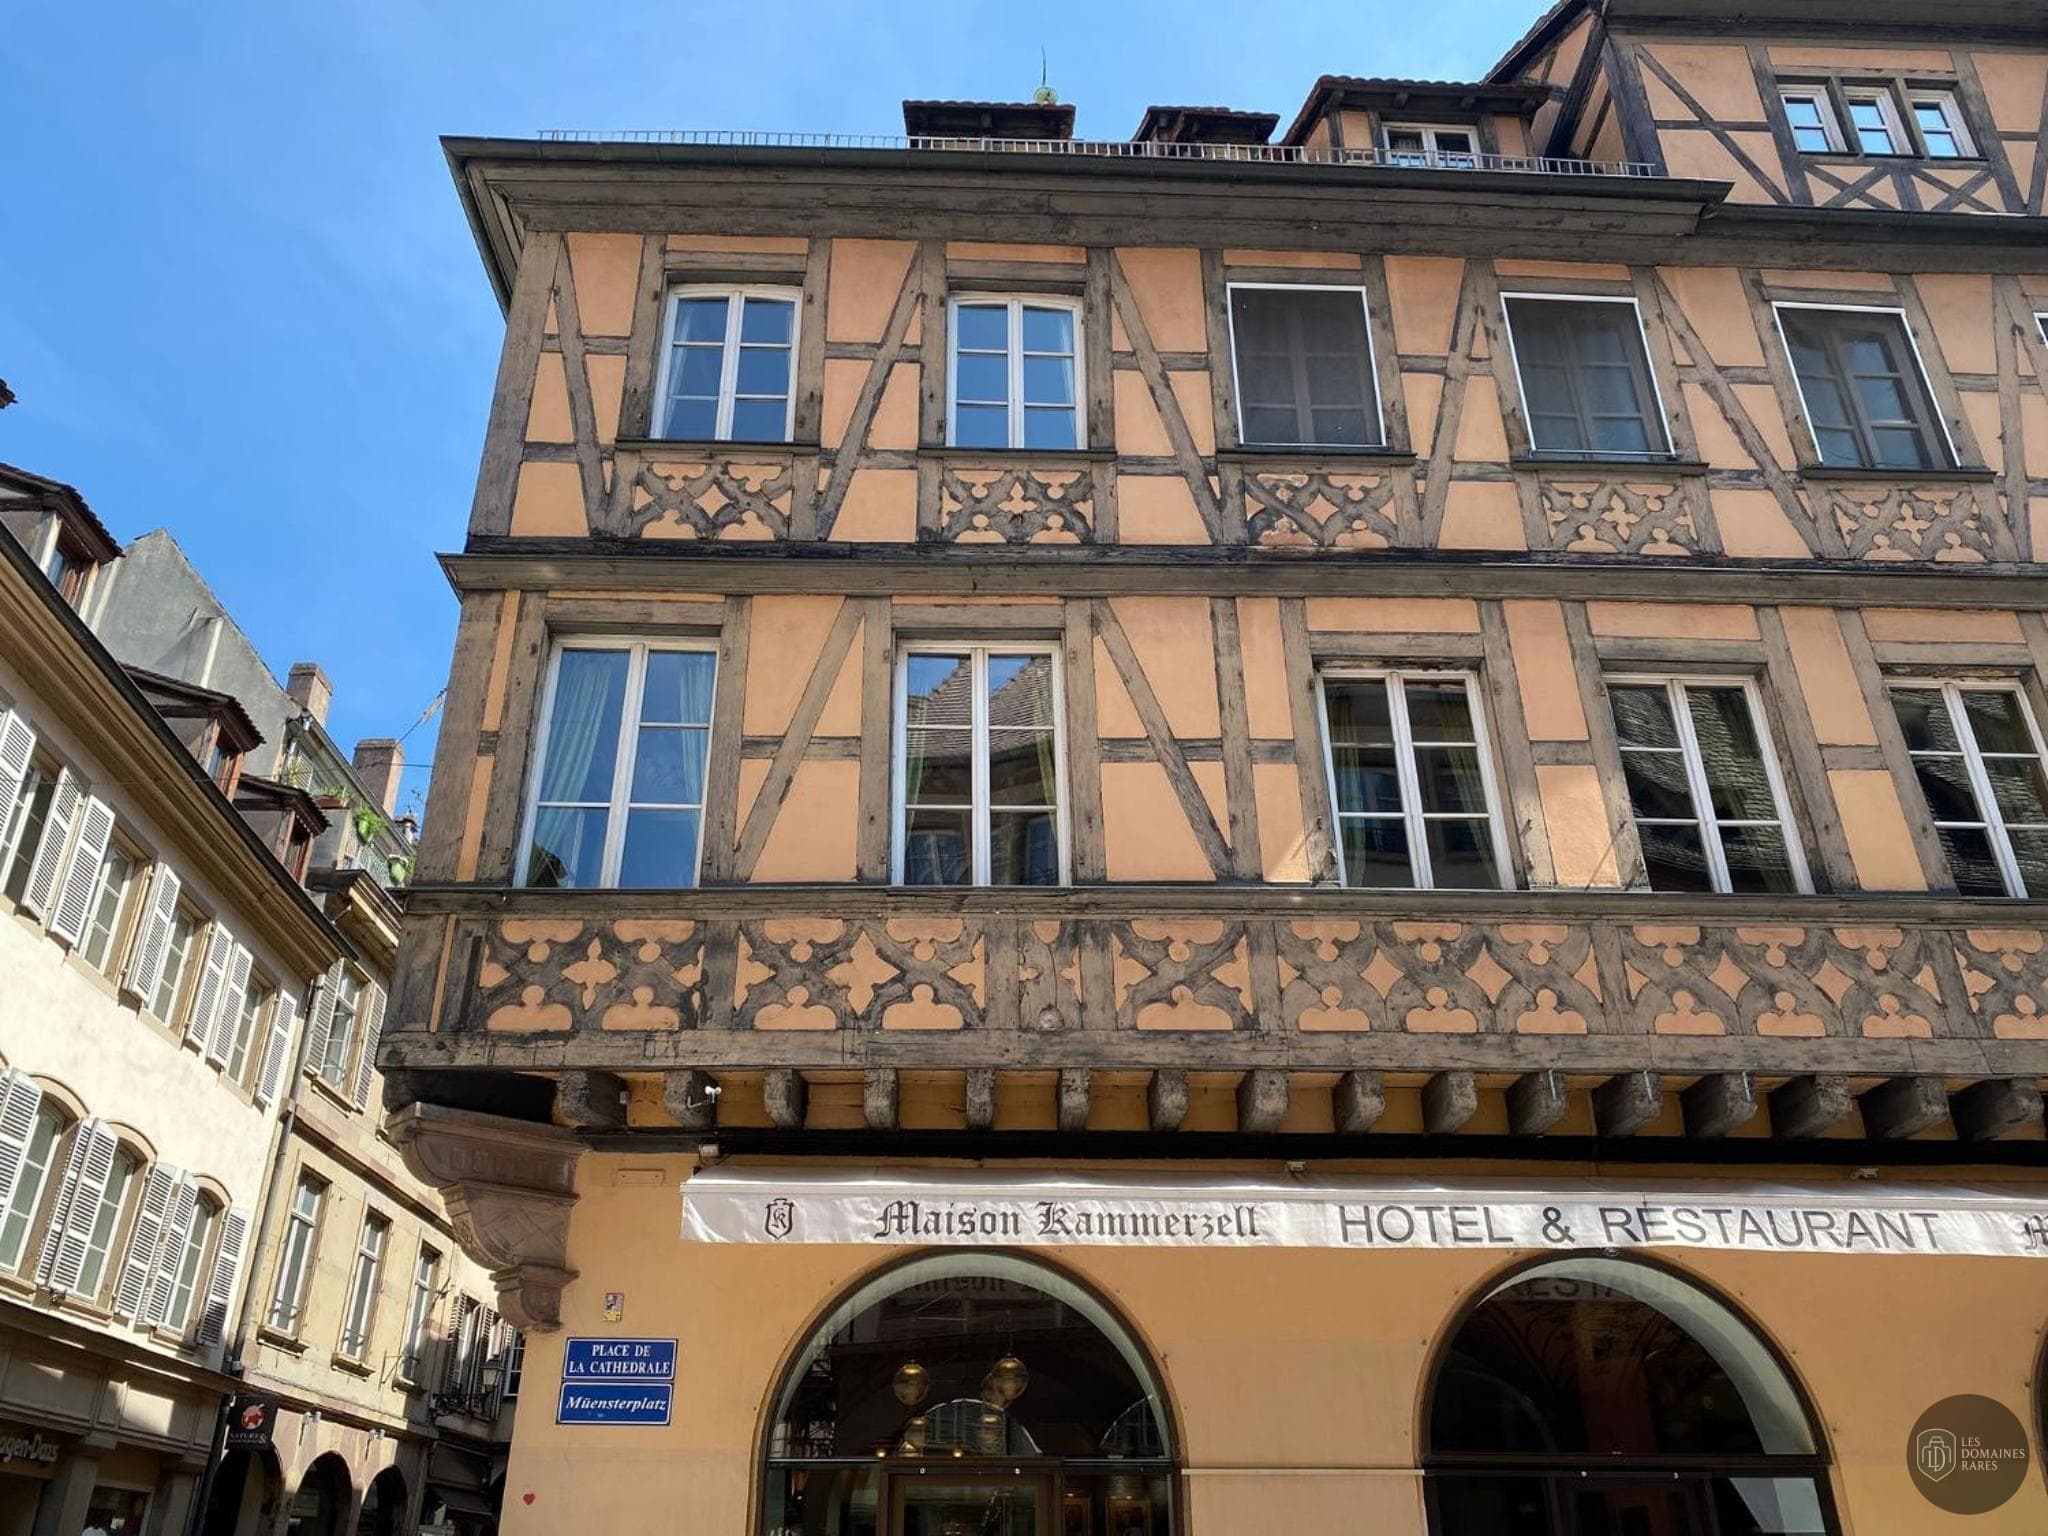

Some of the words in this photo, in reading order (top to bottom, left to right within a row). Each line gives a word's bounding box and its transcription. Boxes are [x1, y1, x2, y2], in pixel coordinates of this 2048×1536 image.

[874, 1200, 1020, 1238] Maison
[1036, 1201, 1260, 1244] Kammerzell
[1338, 1205, 1514, 1243] HOTEL
[1541, 1206, 1576, 1244] &
[1598, 1206, 1940, 1249] RESTAURANT
[591, 1344, 630, 1357] PLACE
[634, 1345, 652, 1357] DE
[568, 1361, 585, 1373] LA
[589, 1361, 670, 1375] CATHEDRALE
[565, 1396, 668, 1413] Müensterplatz
